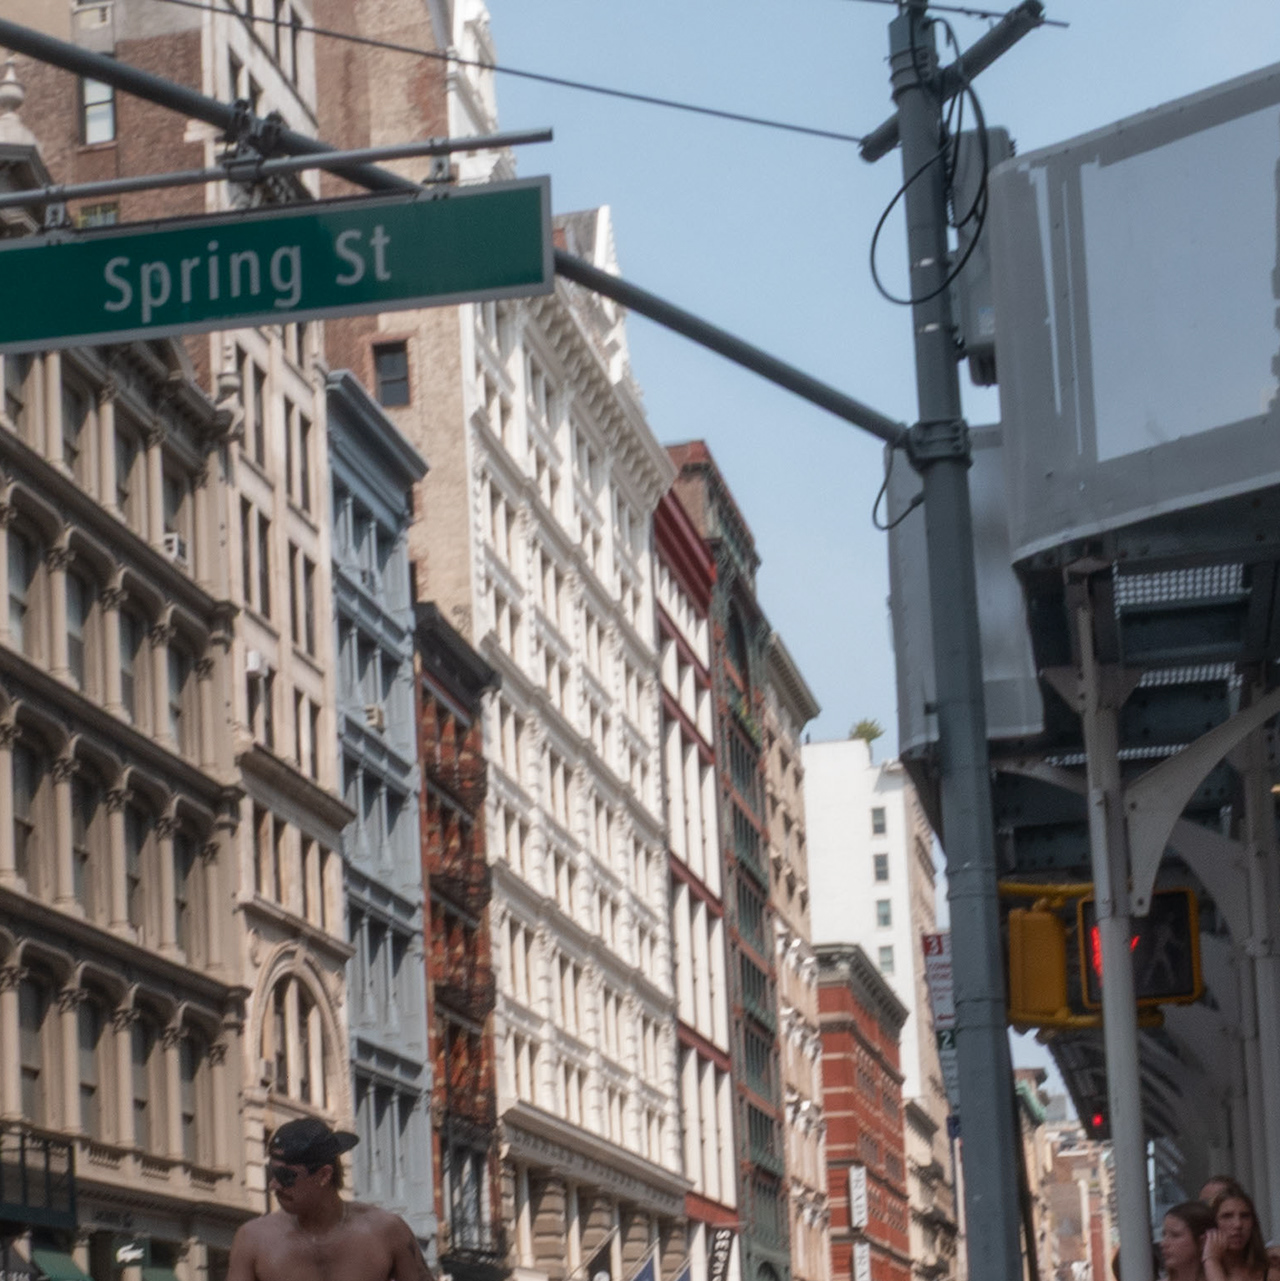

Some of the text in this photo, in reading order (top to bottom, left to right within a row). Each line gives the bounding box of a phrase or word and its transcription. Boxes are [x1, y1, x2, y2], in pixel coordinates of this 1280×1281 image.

[103, 226, 391, 324] Spring St
[940, 1029, 953, 1050] 2
